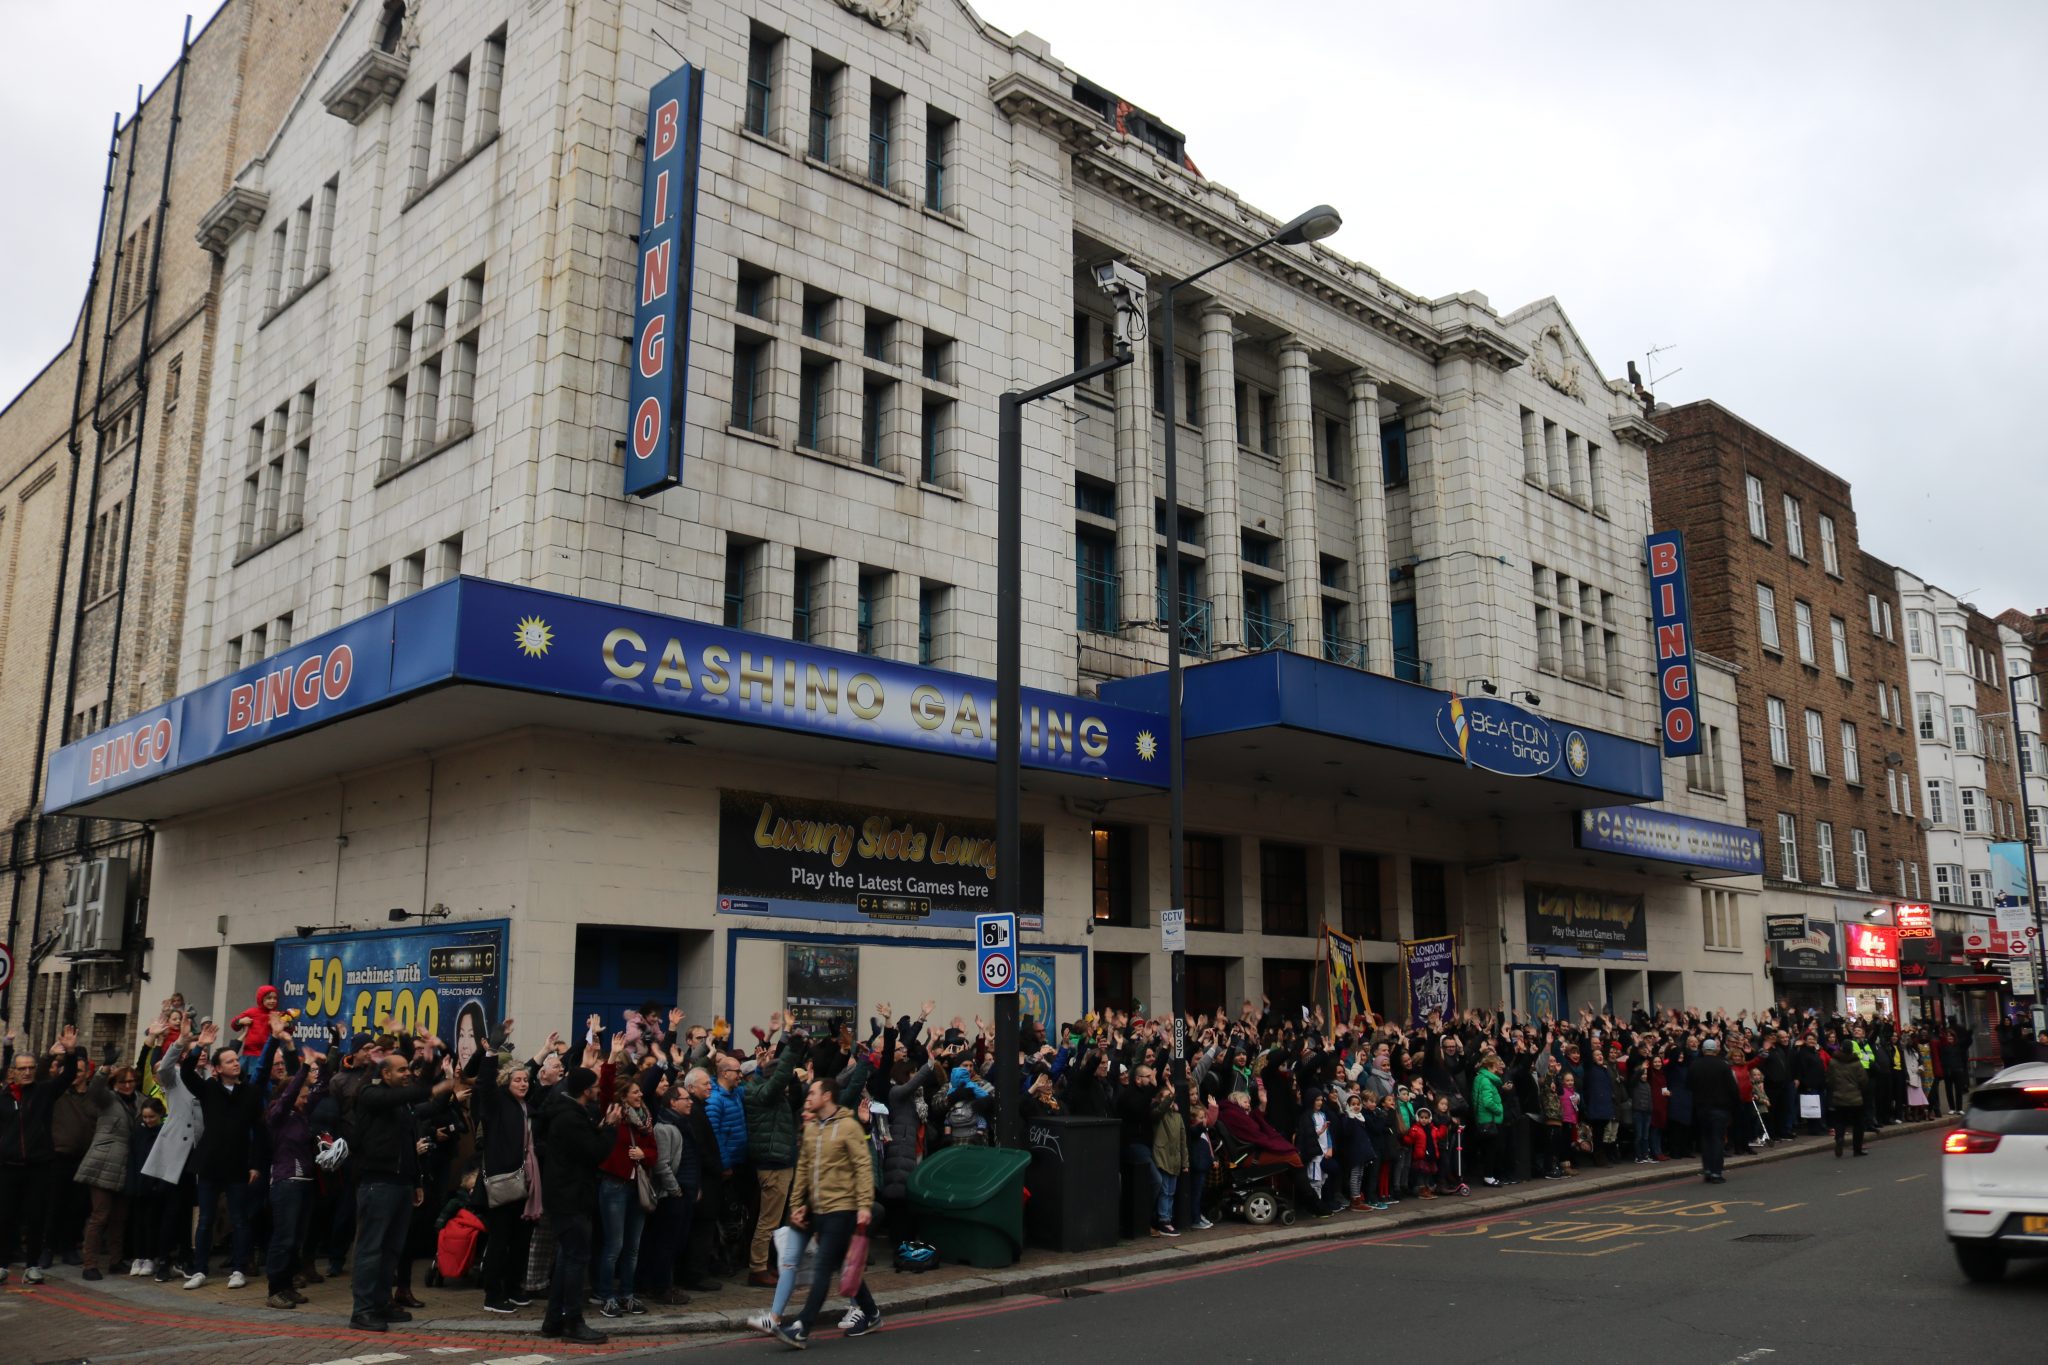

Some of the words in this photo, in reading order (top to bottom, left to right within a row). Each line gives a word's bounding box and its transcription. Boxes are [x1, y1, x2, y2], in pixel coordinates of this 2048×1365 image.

[633, 98, 679, 459] BINGO
[1650, 542, 1693, 742] BINGO
[227, 644, 353, 734] BINGO
[602, 627, 885, 720] CASHINO
[910, 685, 1109, 757] GAING
[1471, 711, 1548, 747] BEACON
[88, 718, 172, 785] BINGO
[1512, 741, 1550, 765] bingo
[754, 802, 854, 868] Luxury
[858, 815, 927, 862] Slots
[930, 822, 997, 879] Loung
[1597, 811, 1680, 849] CASHINO
[1688, 828, 1751, 861] GAMING
[791, 867, 824, 889] Play
[829, 872, 854, 888] the
[859, 874, 902, 892] Latest
[906, 877, 954, 896] Games
[958, 881, 989, 897] here
[1162, 912, 1182, 921] CCTV
[986, 964, 1007, 978] 30
[1416, 943, 1445, 956] LONDON
[284, 980, 304, 996] Over
[305, 956, 343, 1017] 50
[346, 964, 394, 985] machines
[397, 963, 421, 983] with
[292, 1021, 321, 1043] ckpots
[352, 988, 439, 1041] £500
[1175, 1019, 1183, 1058] 0837
[1428, 1219, 1690, 1244] STOP
